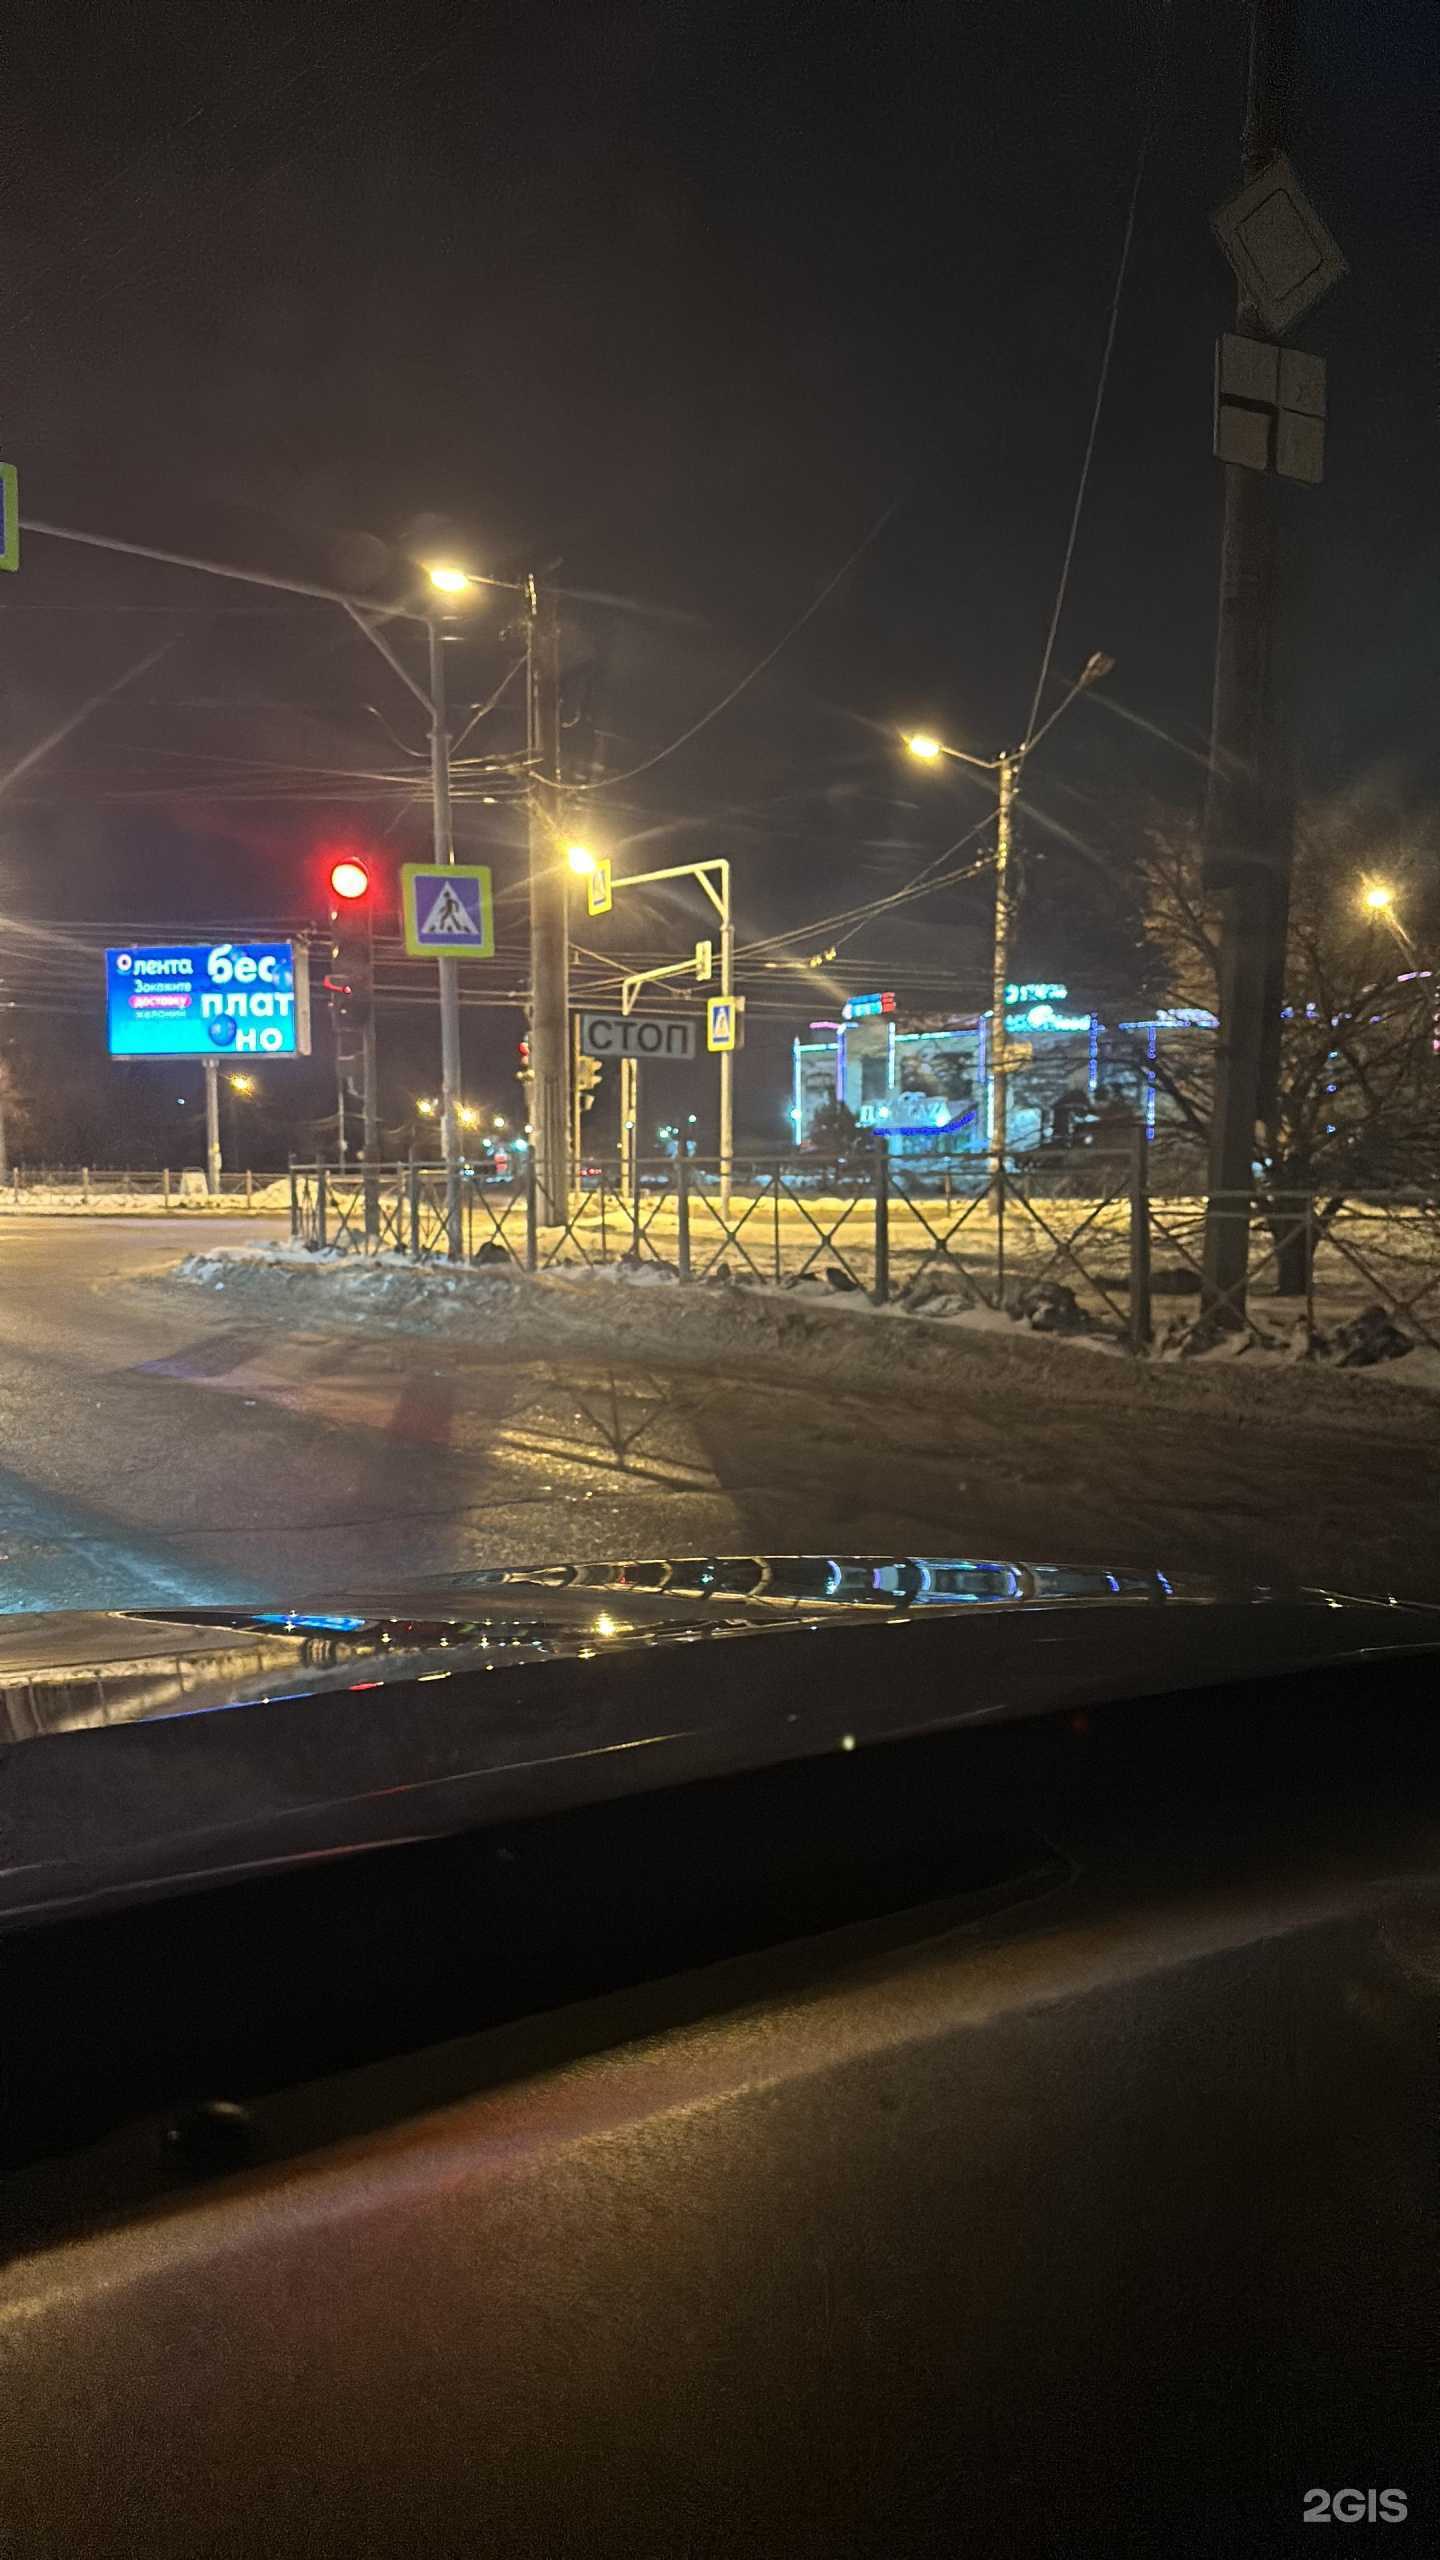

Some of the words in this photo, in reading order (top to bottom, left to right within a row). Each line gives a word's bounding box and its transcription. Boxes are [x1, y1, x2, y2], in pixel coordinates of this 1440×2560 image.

[133, 957, 194, 976] лента
[207, 944, 276, 984] бес
[201, 991, 295, 1018] плат
[235, 1027, 283, 1052] но
[588, 1019, 688, 1053] СТОП
